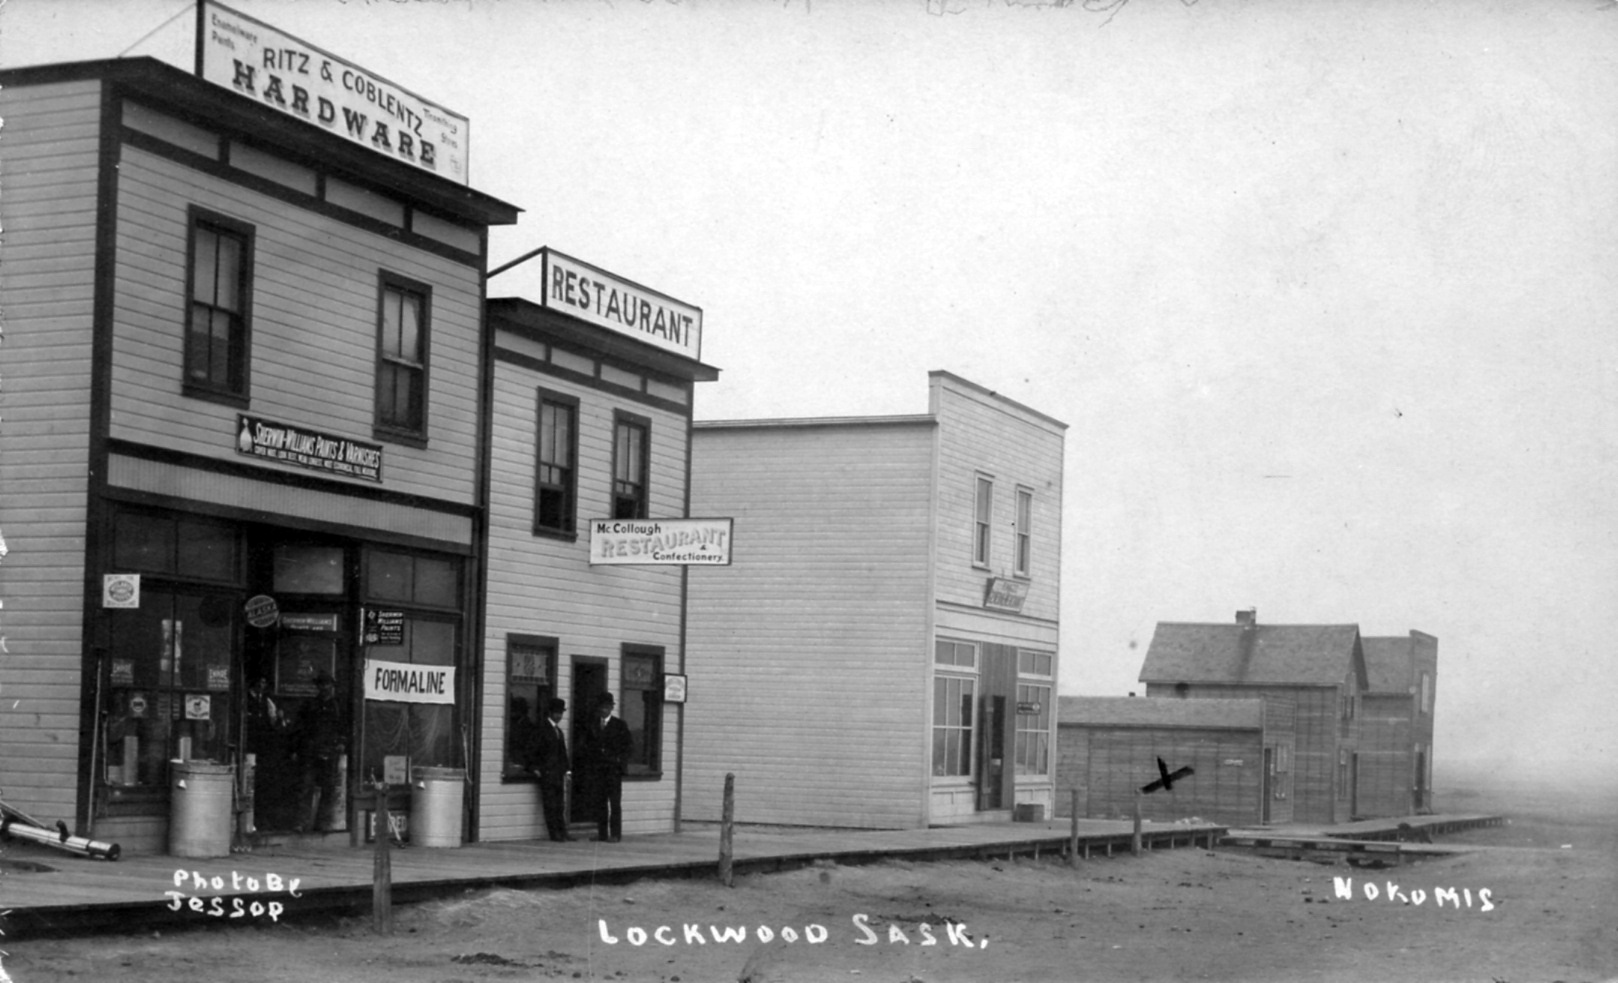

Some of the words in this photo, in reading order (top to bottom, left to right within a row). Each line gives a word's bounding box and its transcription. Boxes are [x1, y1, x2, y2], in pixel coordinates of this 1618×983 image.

[232, 58, 436, 168] HARDWARE
[263, 47, 310, 75] RITZ
[320, 60, 334, 83] &
[342, 70, 423, 138] COBLENTZ
[552, 264, 693, 347] RESTAURANT
[314, 436, 338, 459] PAINTS
[601, 527, 727, 558] RESTAURANT
[375, 667, 446, 694] FORMALINE
